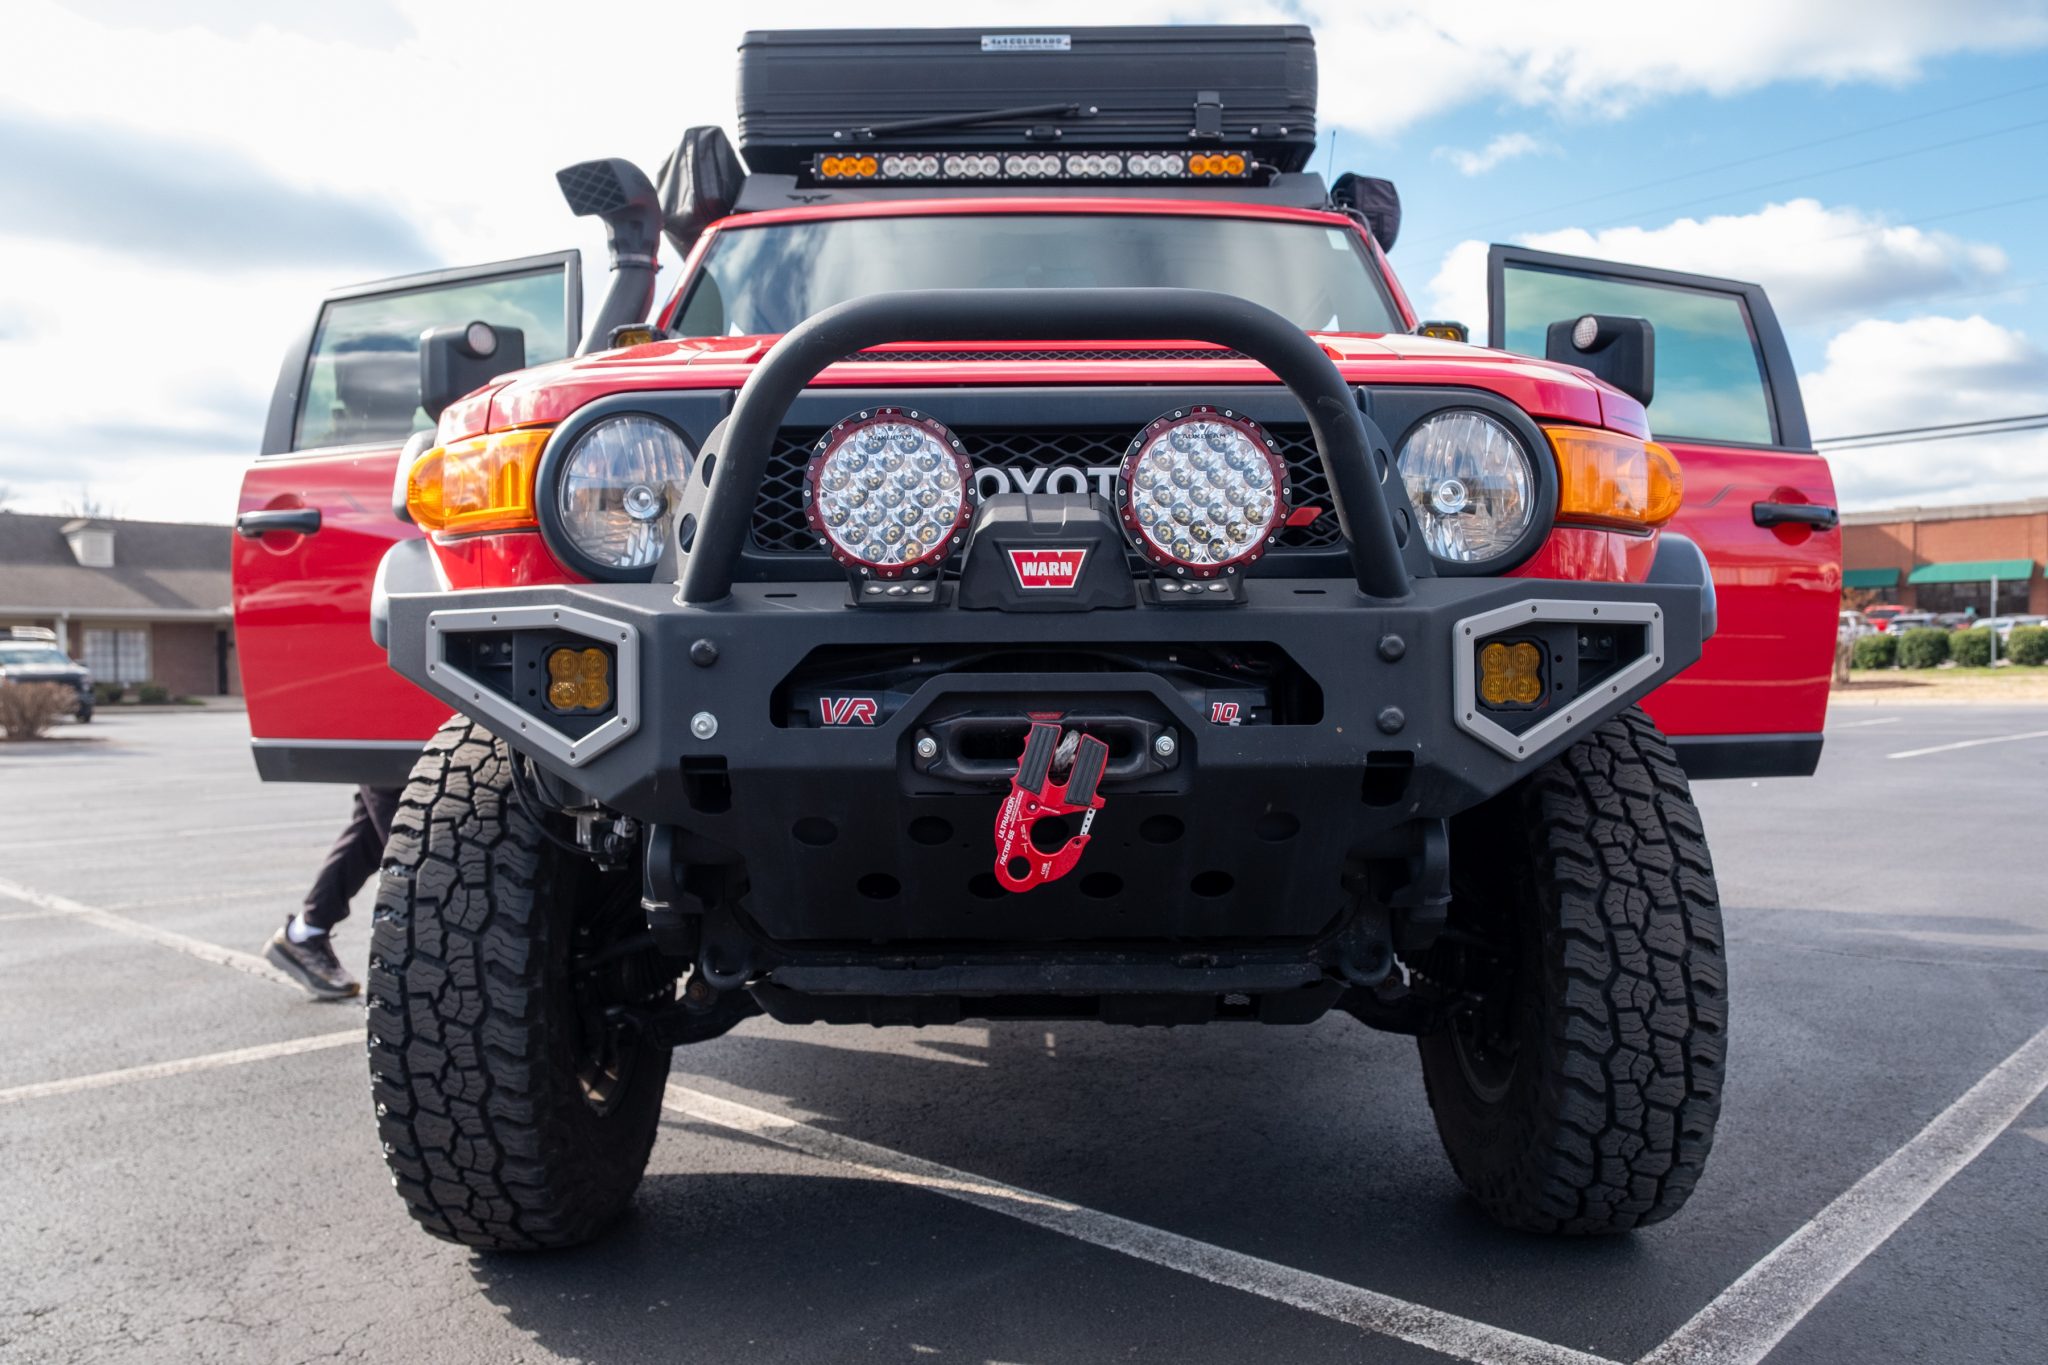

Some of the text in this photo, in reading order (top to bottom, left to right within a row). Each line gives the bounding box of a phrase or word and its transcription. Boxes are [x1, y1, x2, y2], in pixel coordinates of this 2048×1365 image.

[974, 466, 1121, 504] OYOT
[1021, 561, 1073, 576] WARN
[820, 697, 878, 725] VR
[998, 796, 1016, 839] ULTRAHOOK
[1000, 839, 1012, 866] FACTOR
